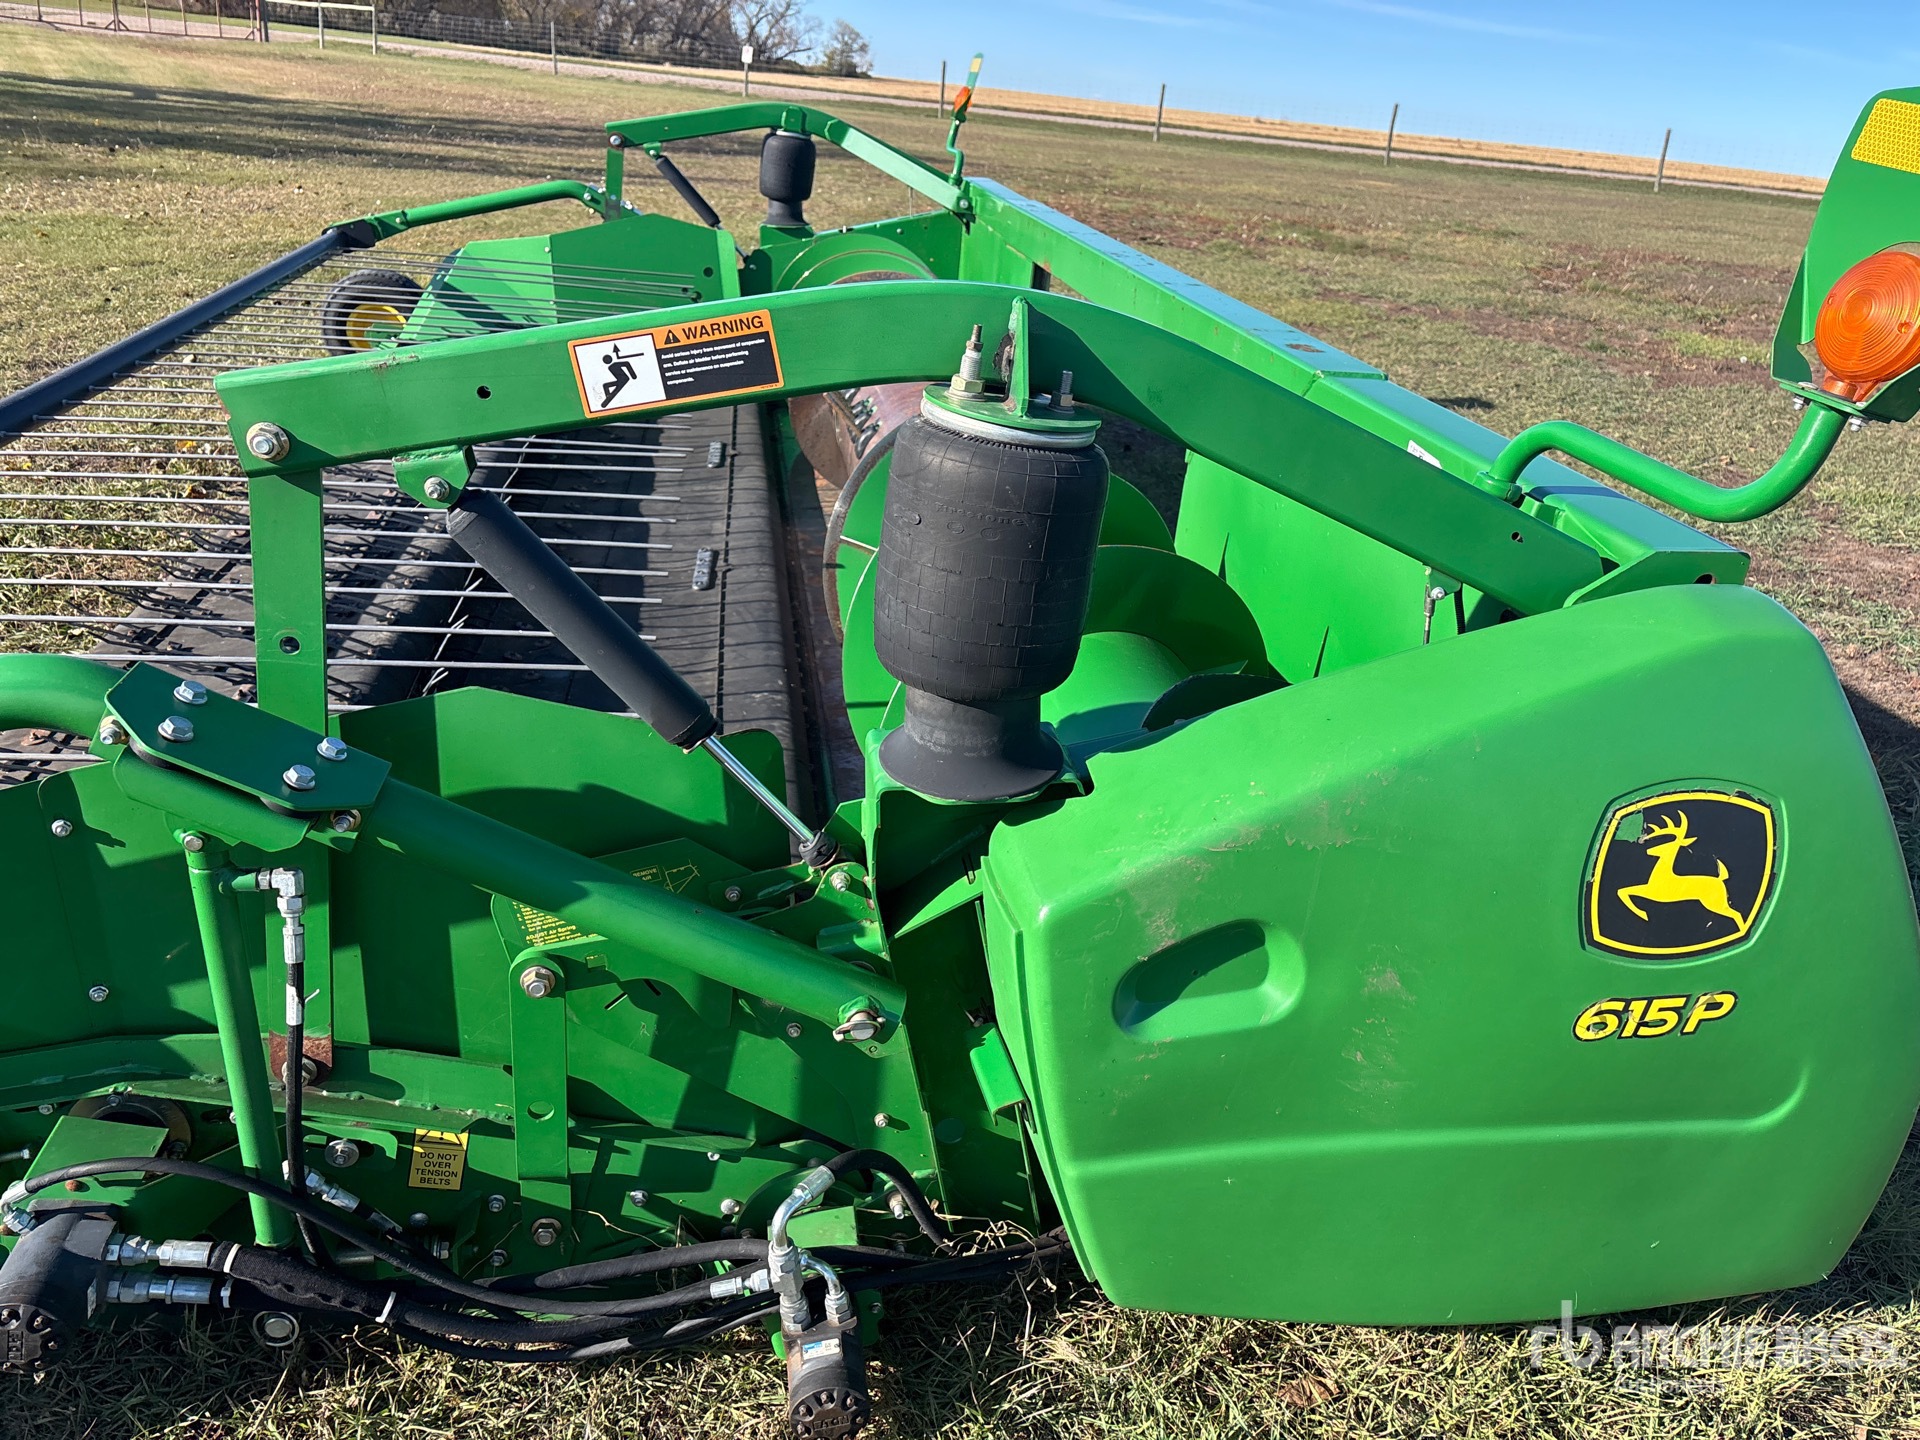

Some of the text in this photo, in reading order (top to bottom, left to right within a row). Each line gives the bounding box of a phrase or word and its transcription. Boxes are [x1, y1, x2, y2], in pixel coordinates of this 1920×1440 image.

[682, 316, 764, 340] WARNING
[424, 1160, 451, 1169] OVER
[415, 1168, 458, 1178] TENSION
[420, 1177, 451, 1186] BELTS
